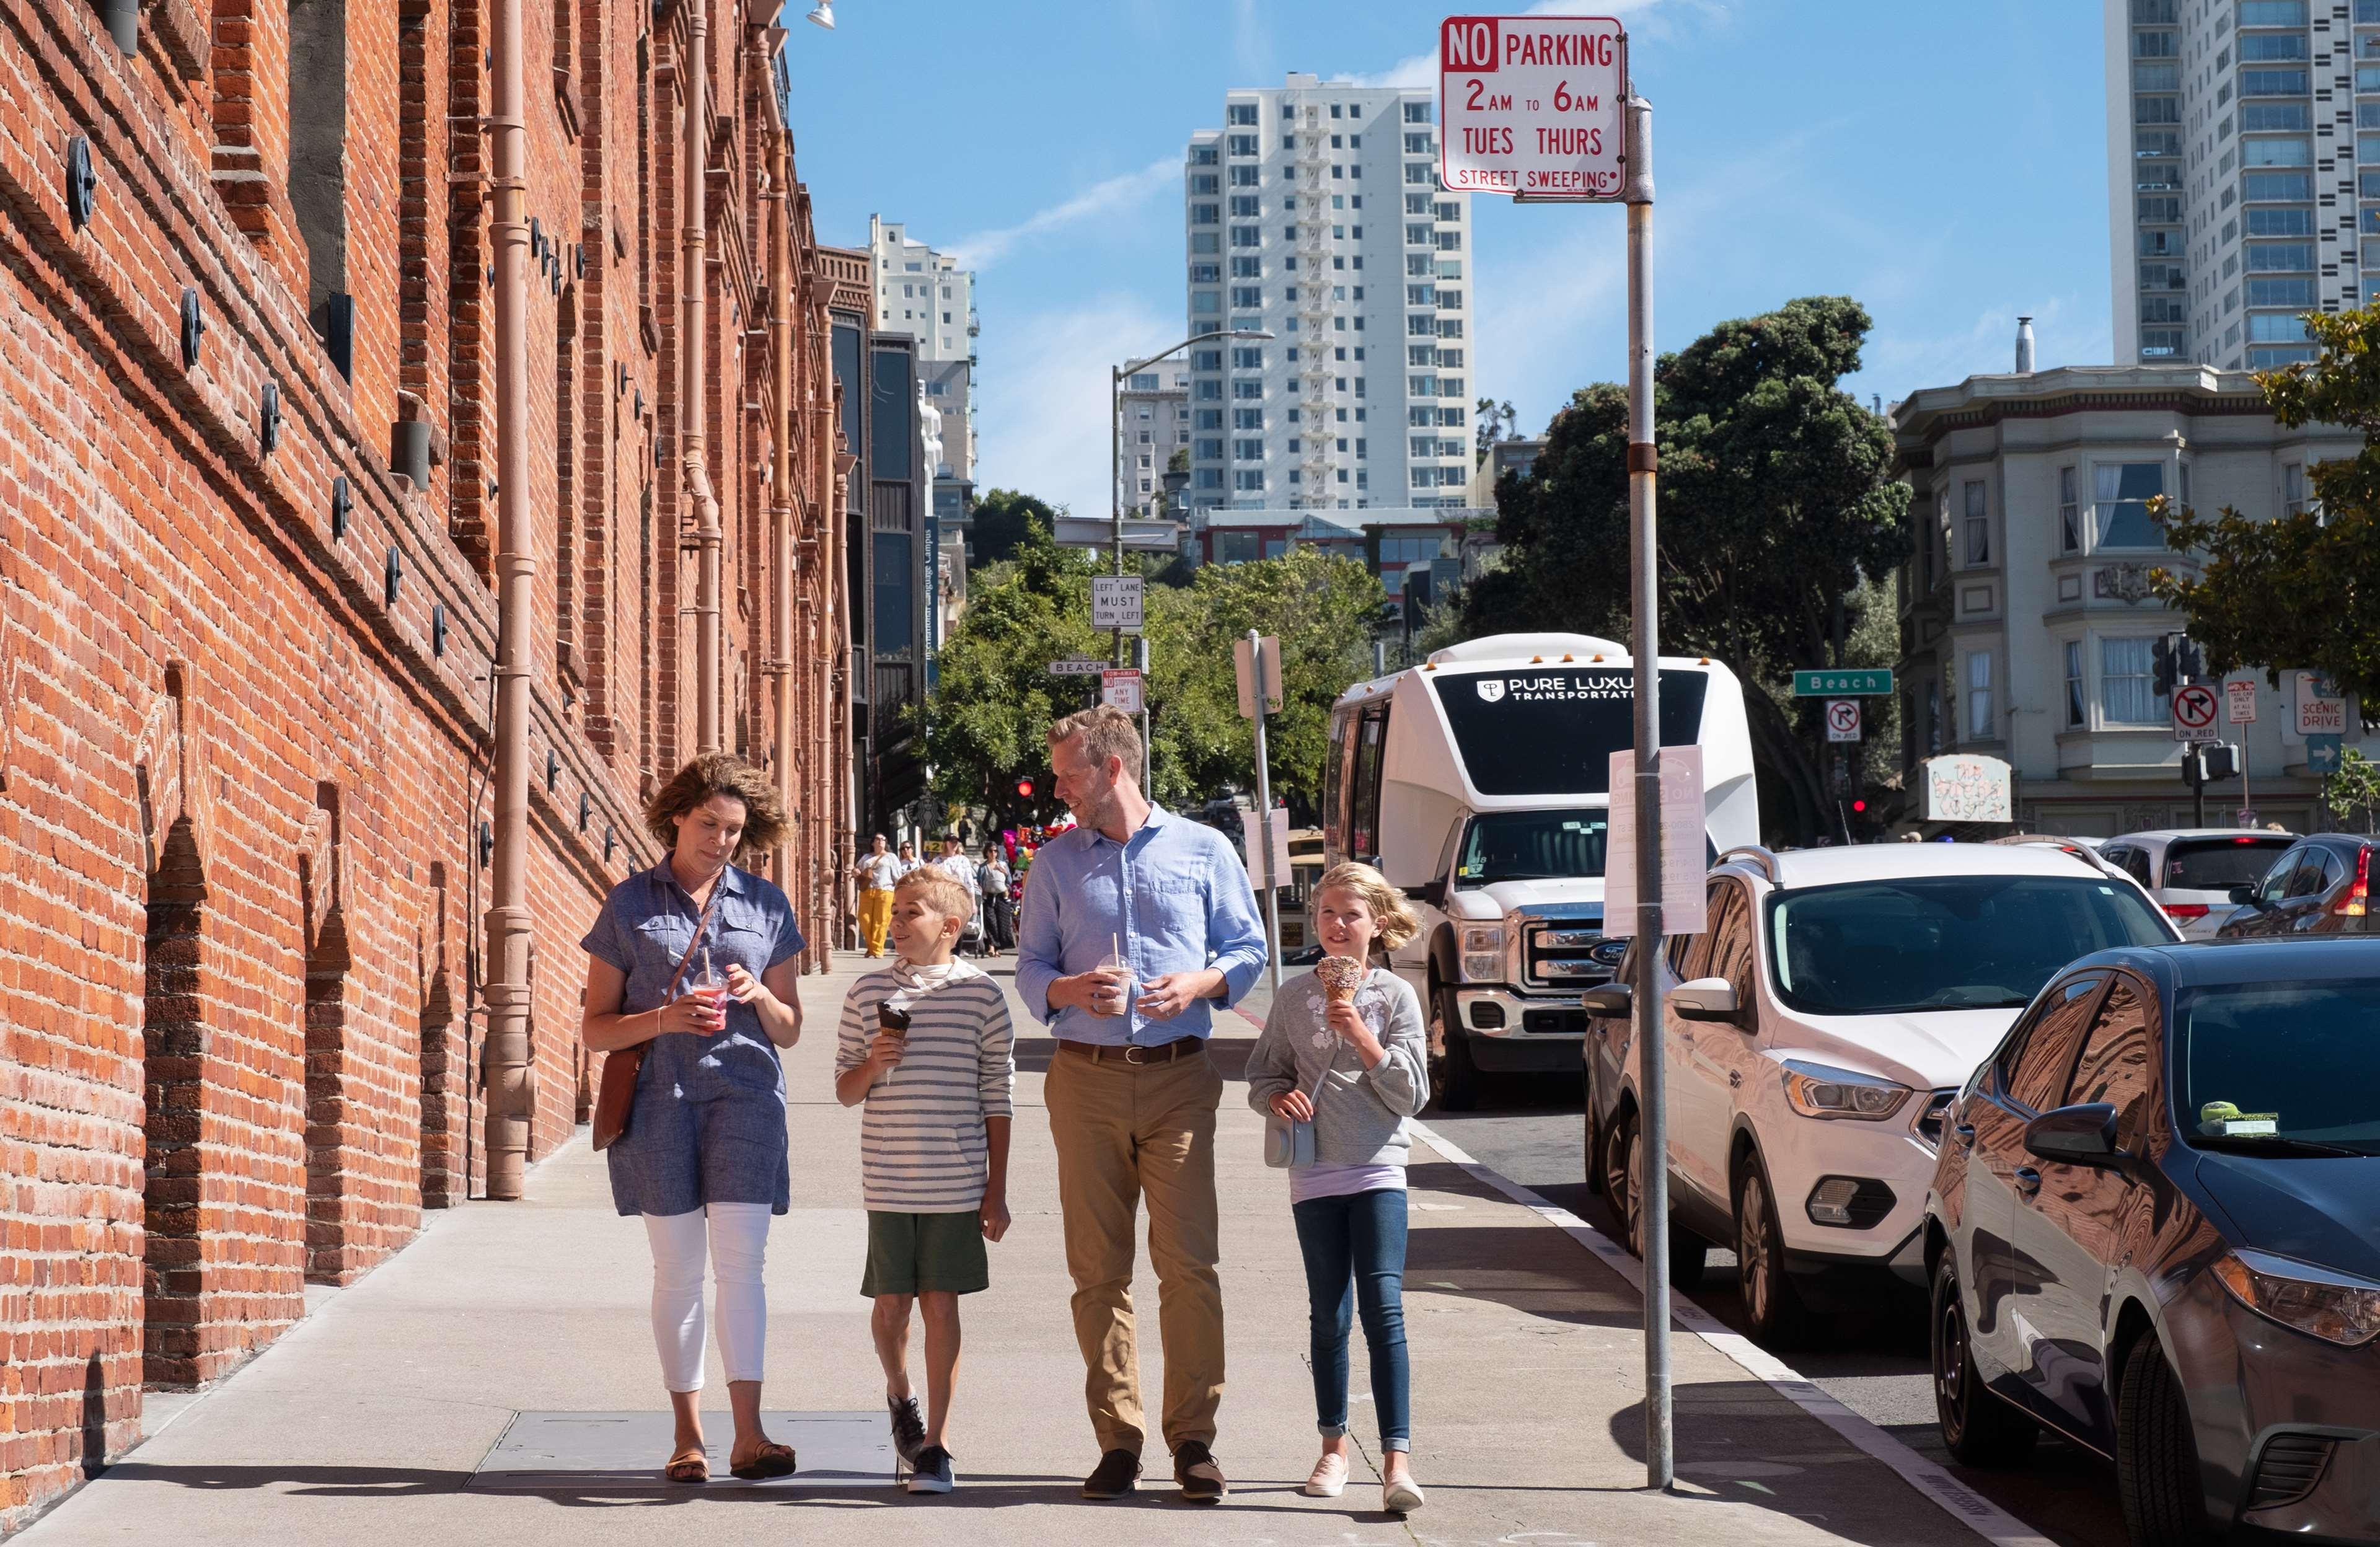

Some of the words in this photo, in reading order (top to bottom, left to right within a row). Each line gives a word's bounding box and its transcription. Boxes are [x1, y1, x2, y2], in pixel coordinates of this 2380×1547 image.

[1448, 22, 1491, 66] NO
[1505, 33, 1612, 66] PARKING
[1526, 100, 1540, 111] TO
[1463, 127, 1514, 155] TUES
[1536, 128, 1602, 156] THURS
[1460, 169, 1518, 186] STREET
[1527, 170, 1607, 188] SWEEPING
[1101, 597, 1134, 606] MUST
[1122, 611, 1139, 619] LEFT
[1056, 664, 1104, 672] BEACH
[1104, 677, 1114, 687] NO
[1509, 677, 1566, 691] PURE
[1576, 677, 1662, 690] LUXU
[1810, 676, 1876, 689] Beach
[2303, 703, 2340, 714] SCENIC
[2303, 715, 2341, 726] DRIVE
[2179, 729, 2191, 738] ON
[2196, 729, 2215, 738] RED
[1603, 946, 1625, 959] For
